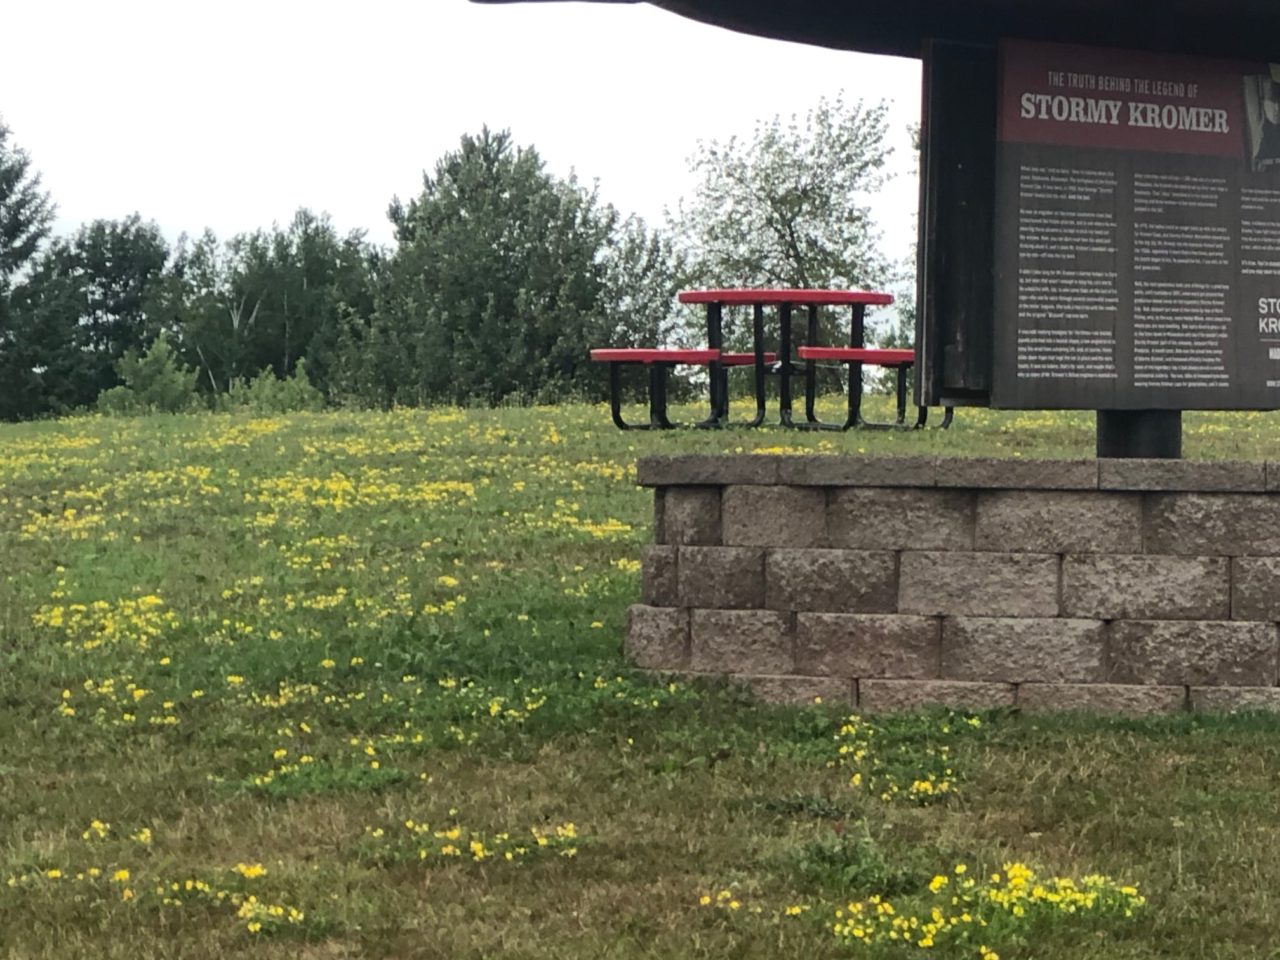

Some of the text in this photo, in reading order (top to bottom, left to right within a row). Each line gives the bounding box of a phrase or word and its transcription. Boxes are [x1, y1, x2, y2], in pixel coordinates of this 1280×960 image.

[1048, 71, 1198, 98] THE TRUTH BEHIND THE LEGEND OF
[1020, 93, 1230, 134] STORMY KROMER
